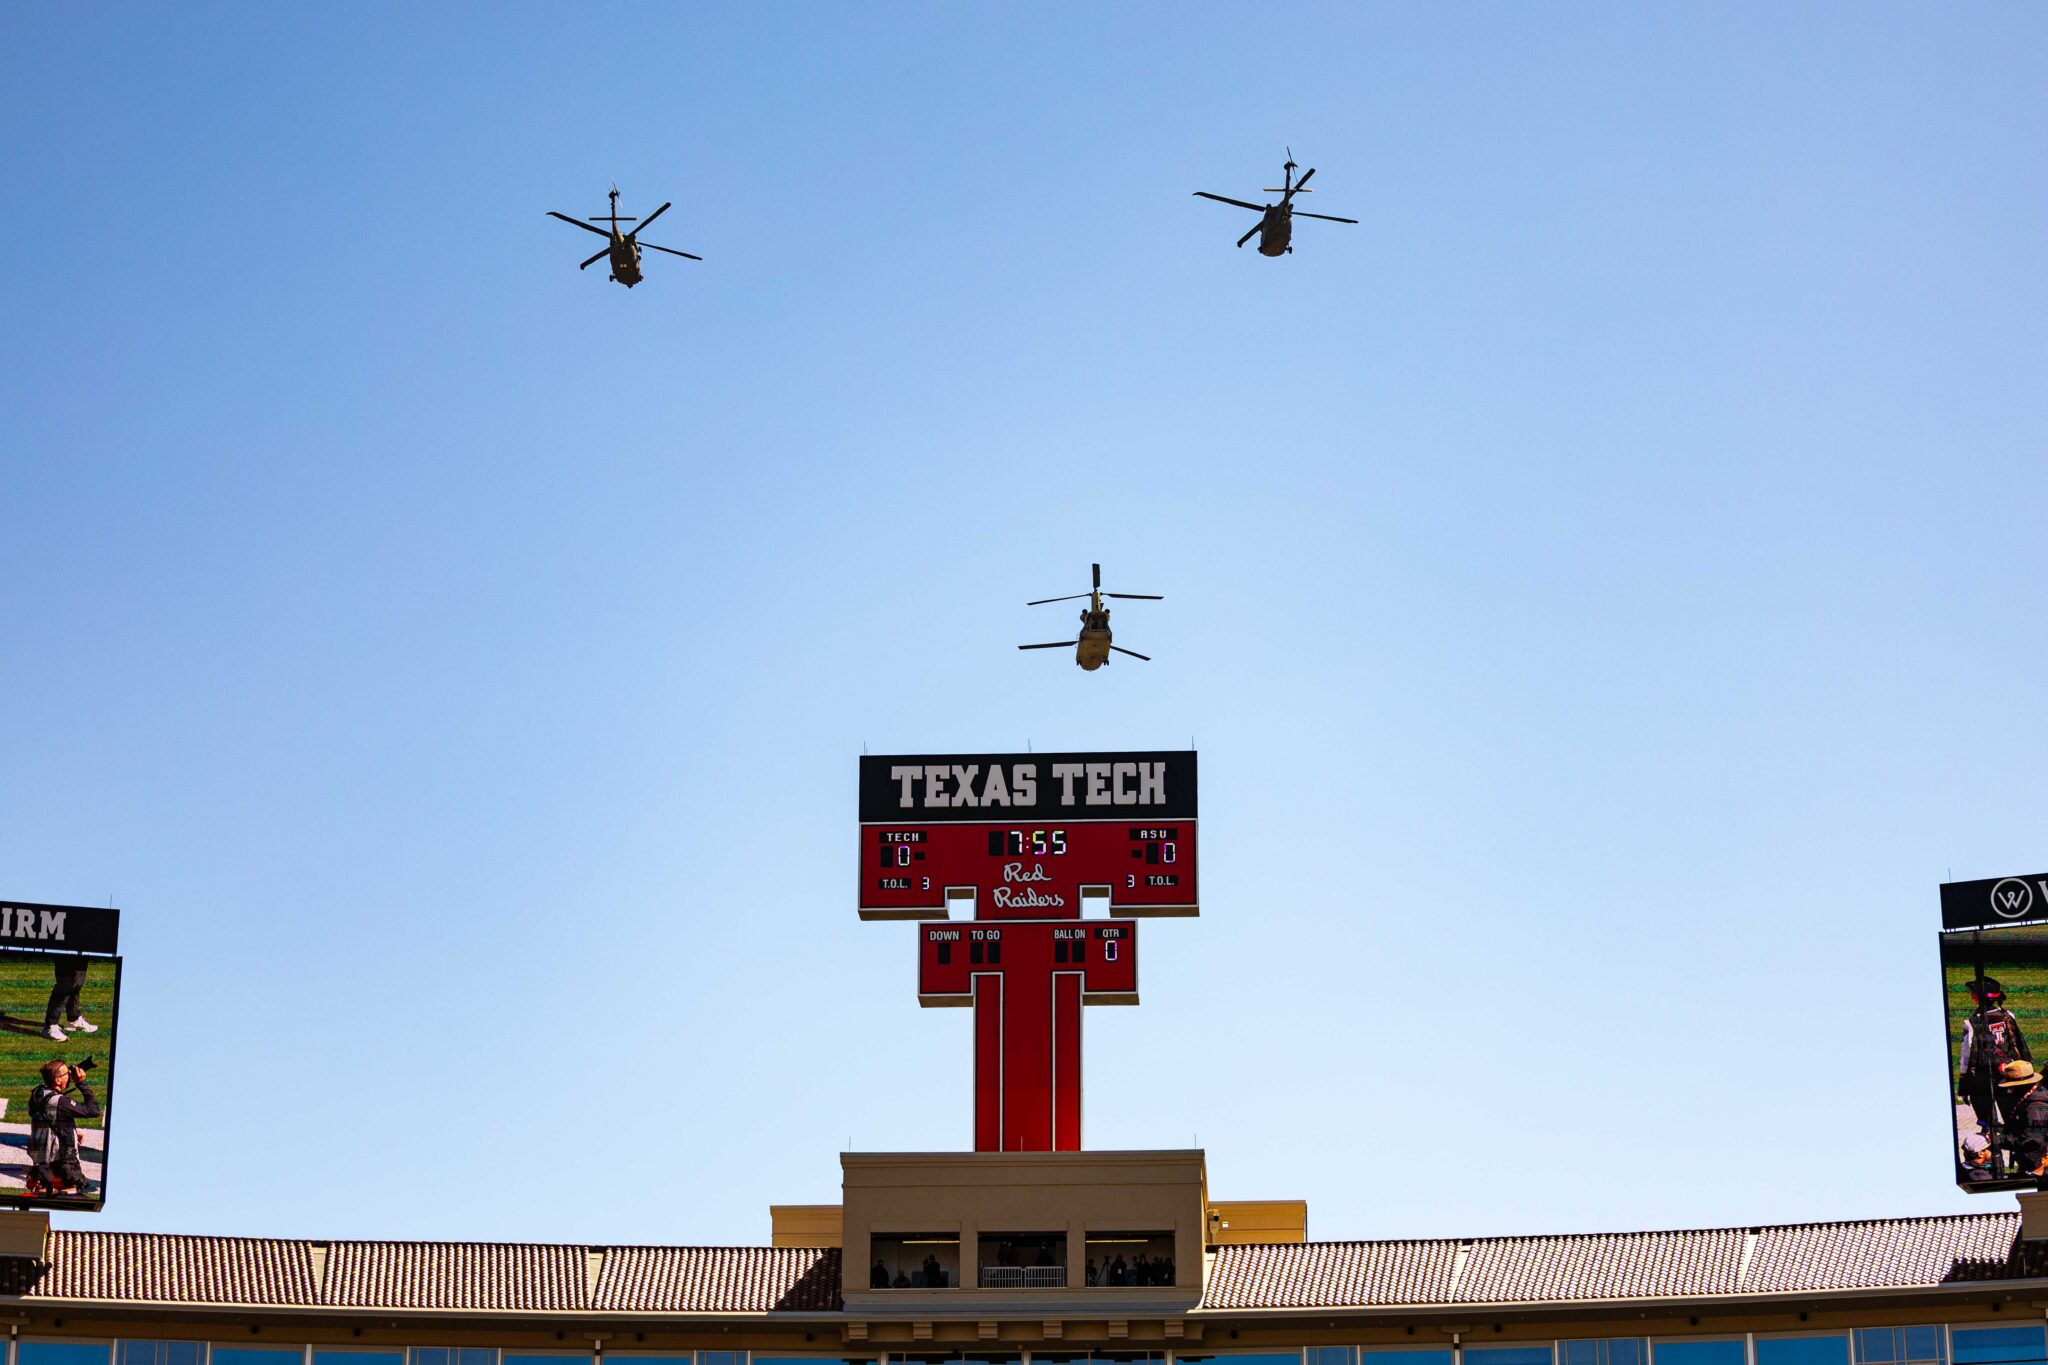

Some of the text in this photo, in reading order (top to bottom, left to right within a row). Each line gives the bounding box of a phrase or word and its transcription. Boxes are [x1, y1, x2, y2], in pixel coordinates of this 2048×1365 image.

[891, 761, 1167, 808] TEXAS TECH
[887, 832, 919, 842] TECH
[1140, 829, 1167, 839] ASU
[1010, 830, 1067, 855] 7:55
[898, 845, 910, 866] 0
[1163, 842, 1176, 863] 0
[1003, 862, 1053, 883] Red
[882, 879, 908, 889] T.O.L.
[922, 876, 930, 890] 3
[1127, 874, 1135, 888] 3
[1149, 875, 1175, 886] T.O.L.
[993, 886, 1065, 908] Raiders
[0, 907, 67, 941] IRM
[929, 930, 960, 941] DOWN
[971, 930, 1000, 941] TO GO
[1054, 929, 1086, 939] BALL ON
[1102, 928, 1120, 938] QTR
[1105, 940, 1118, 960] 0
